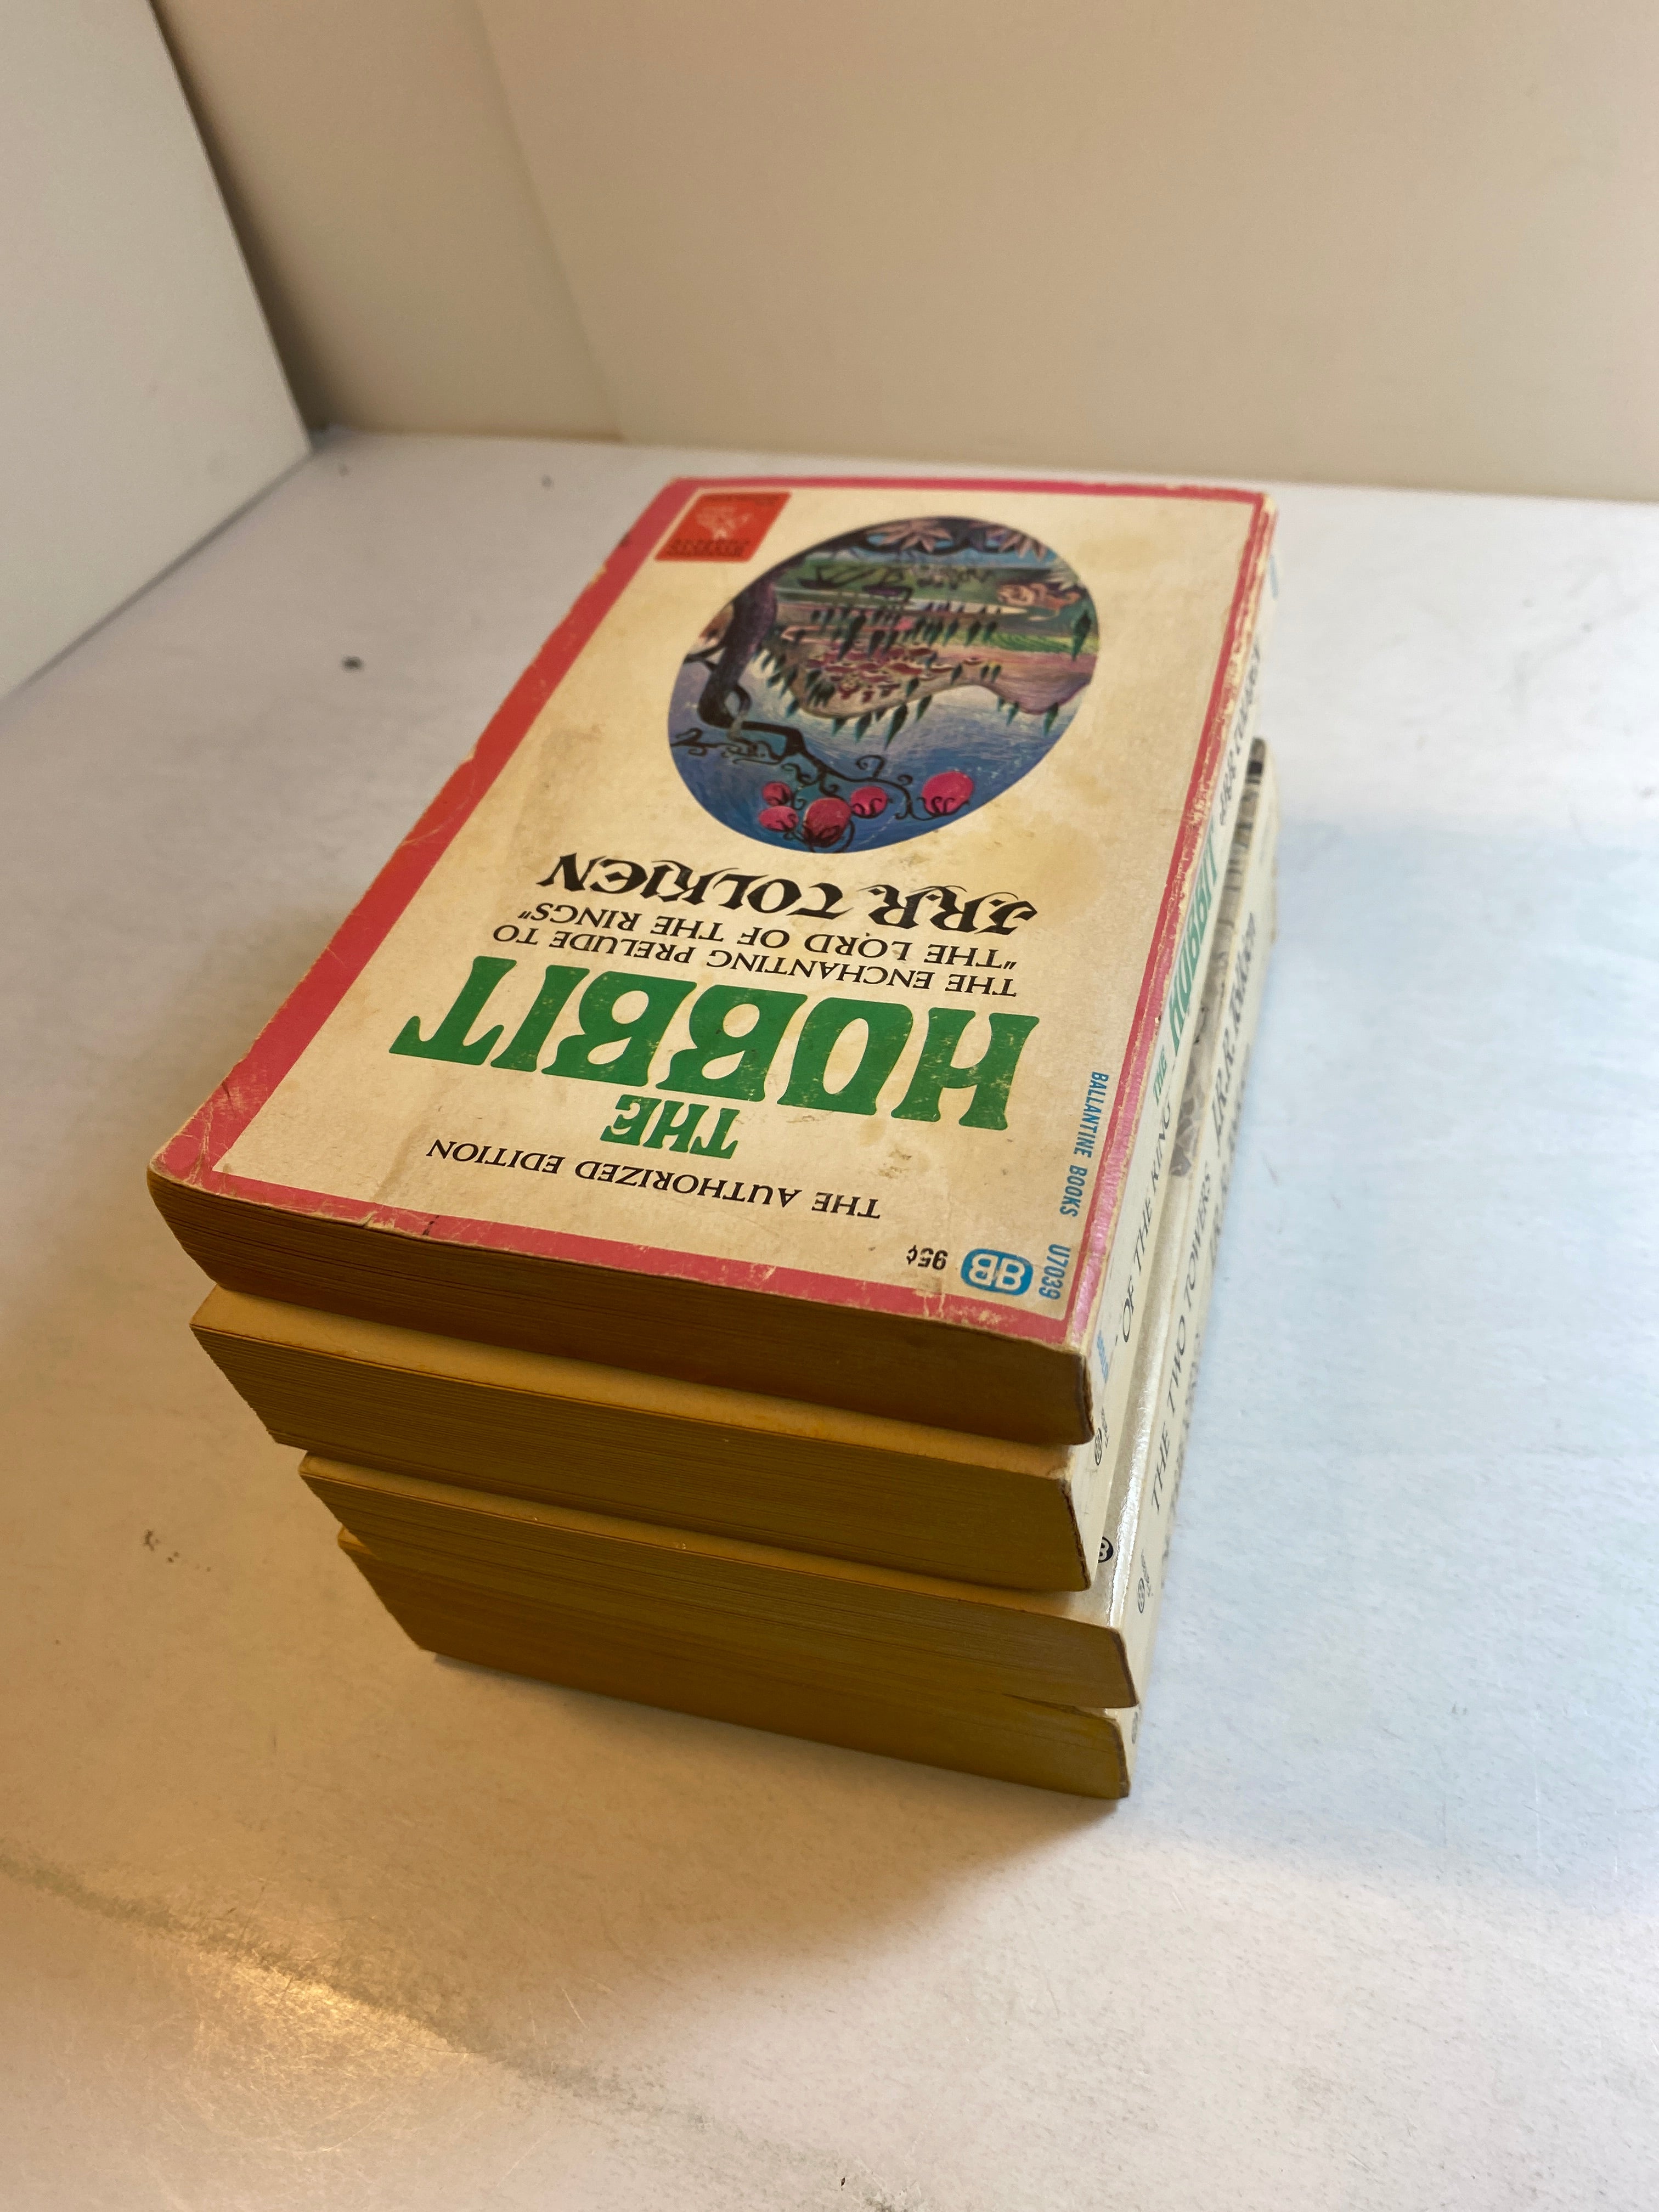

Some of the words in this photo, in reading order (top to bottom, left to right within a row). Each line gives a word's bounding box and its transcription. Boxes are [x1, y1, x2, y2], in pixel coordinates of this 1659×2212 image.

[536, 853, 854, 920] TOLKIEN
[518, 902, 642, 932] RINGS"
[650, 916, 724, 941] THE
[856, 884, 1038, 935] J.R.R.
[493, 925, 539, 945] TO
[549, 930, 696, 964] PRELUDE
[737, 927, 790, 949] OF
[804, 934, 913, 961] LORD
[706, 950, 935, 990] ENCHANTING
[945, 973, 1017, 997] THE
[388, 955, 1040, 1131] HOBBIT
[1153, 1045, 1167, 1106] THE
[600, 1094, 738, 1159] THE
[1074, 1071, 1109, 1158] BALLANTINE
[426, 1139, 566, 1175] EDITION
[575, 1160, 802, 1208] AUTHORIZED
[811, 1192, 880, 1219] THE
[1059, 1165, 1087, 1217] BOOKS
[906, 1244, 949, 1271] 95¢
[1039, 1244, 1071, 1300] U7039
[1122, 1274, 1135, 1342] OF
[1133, 1197, 1152, 1273] THE
[1152, 1421, 1171, 1515] THE
[1167, 1314, 1186, 1417] TWO
[1184, 1160, 1210, 1313] TOWERS
